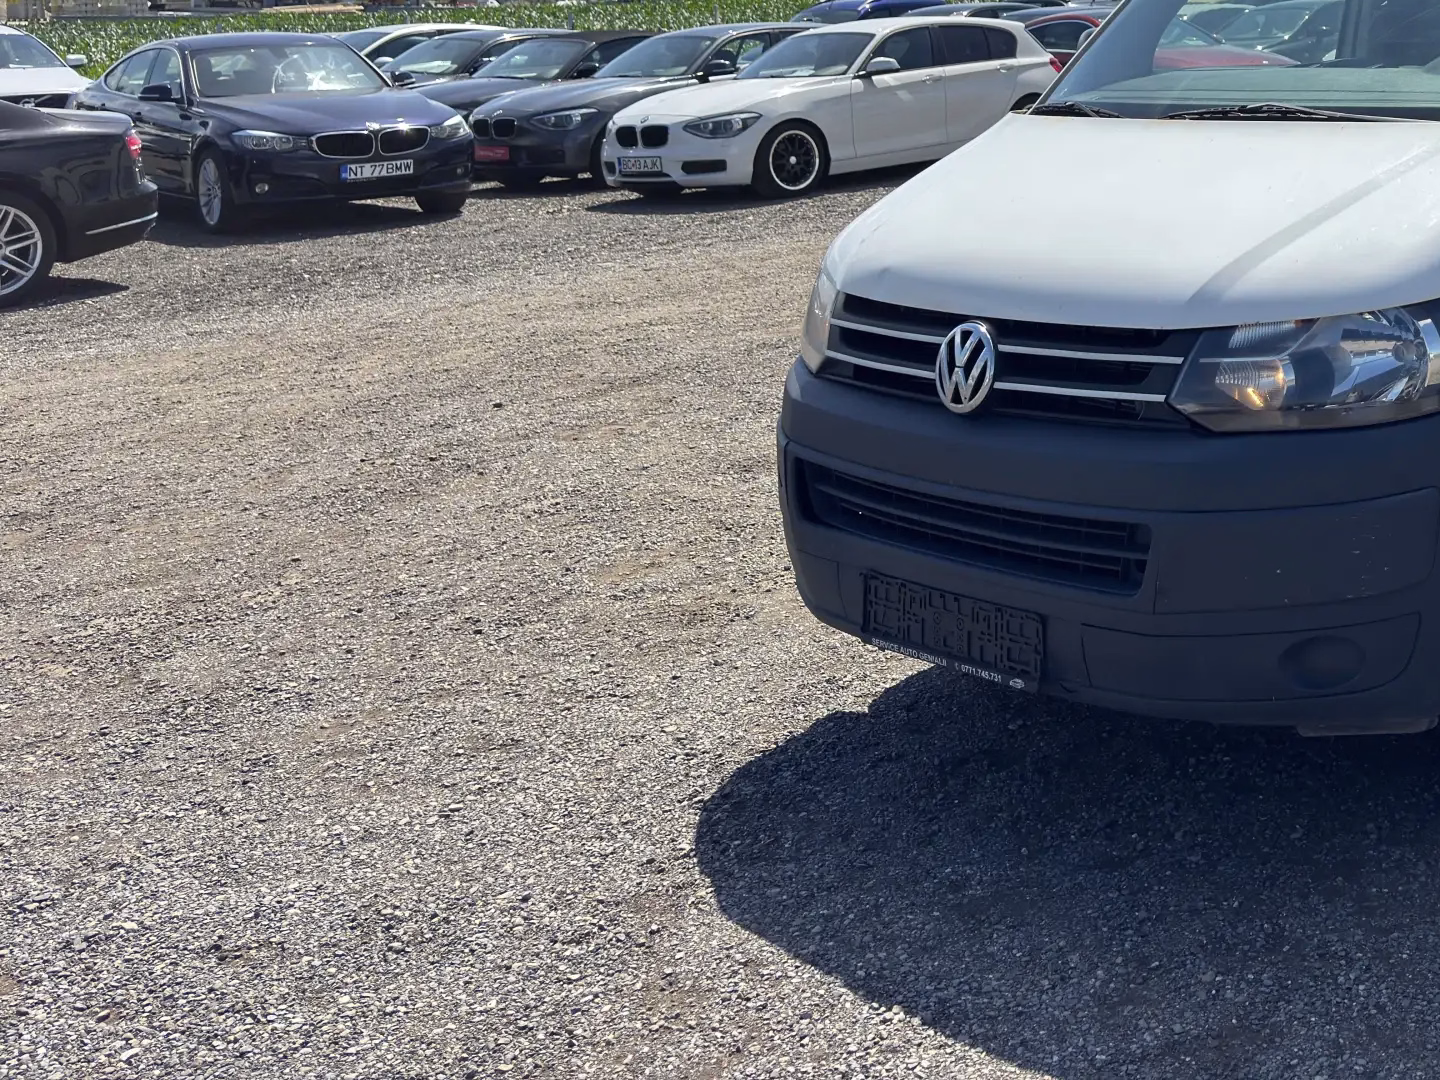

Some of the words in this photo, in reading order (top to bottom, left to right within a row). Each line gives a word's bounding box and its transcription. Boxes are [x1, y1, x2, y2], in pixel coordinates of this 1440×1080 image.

[348, 165, 366, 177] NT
[871, 638, 899, 652] SERVICE
[900, 646, 918, 658] AUTO
